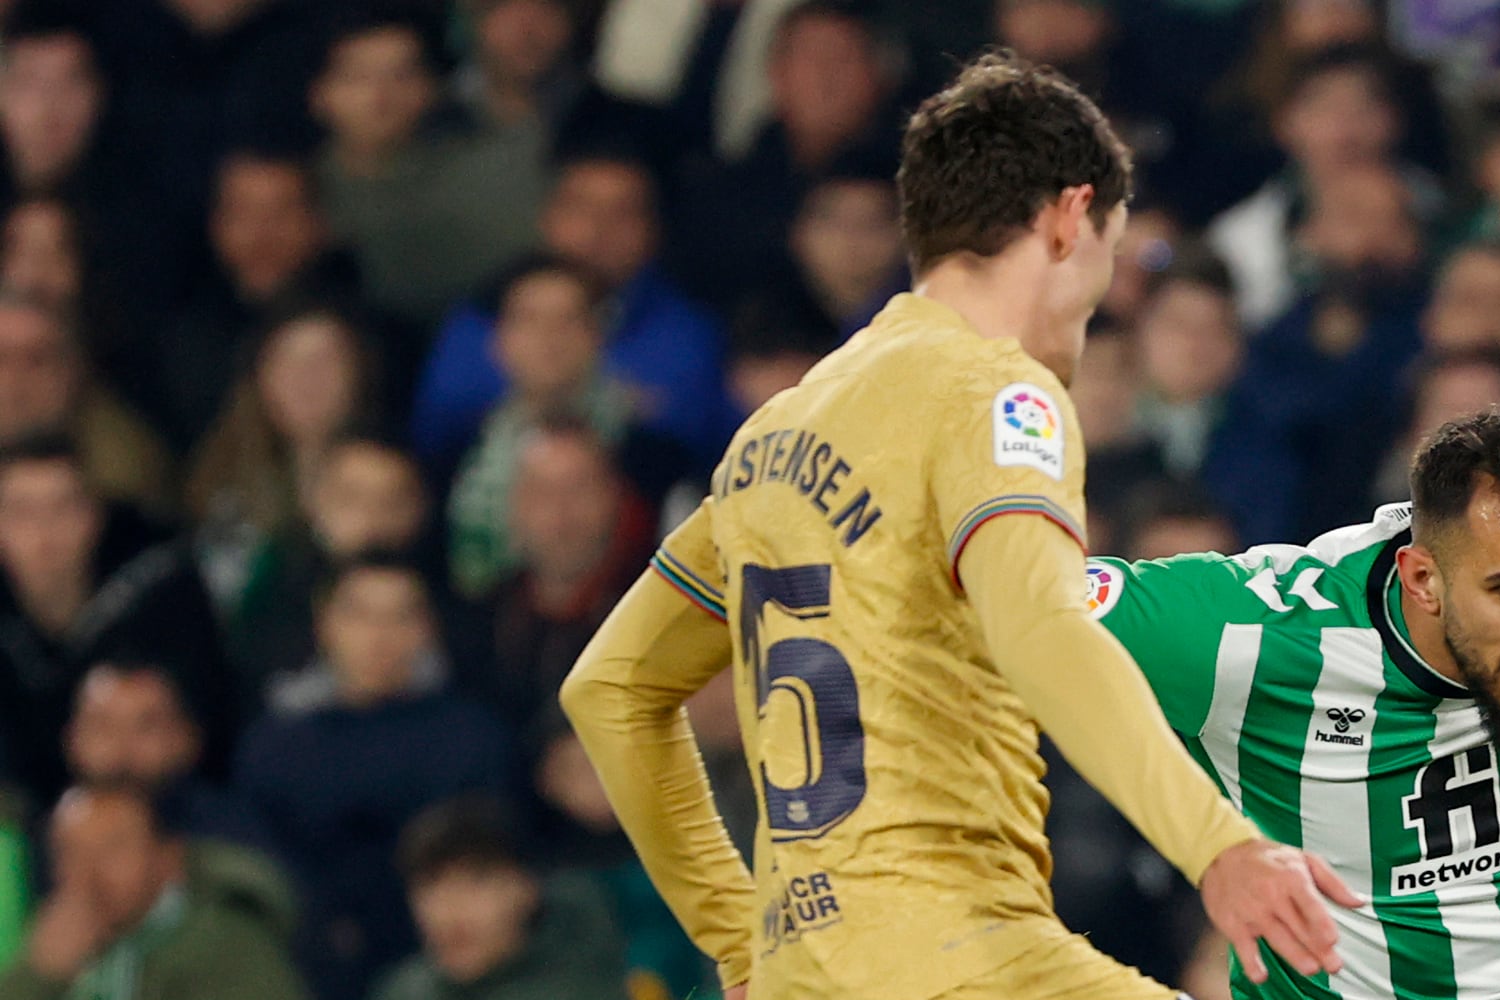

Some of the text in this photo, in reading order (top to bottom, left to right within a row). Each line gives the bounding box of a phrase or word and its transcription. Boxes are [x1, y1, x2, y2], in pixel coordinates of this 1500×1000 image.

[711, 429, 883, 548] ISTENSEN
[740, 563, 868, 842] 5
[1315, 730, 1364, 746] hummel
[1408, 744, 1500, 860] fi
